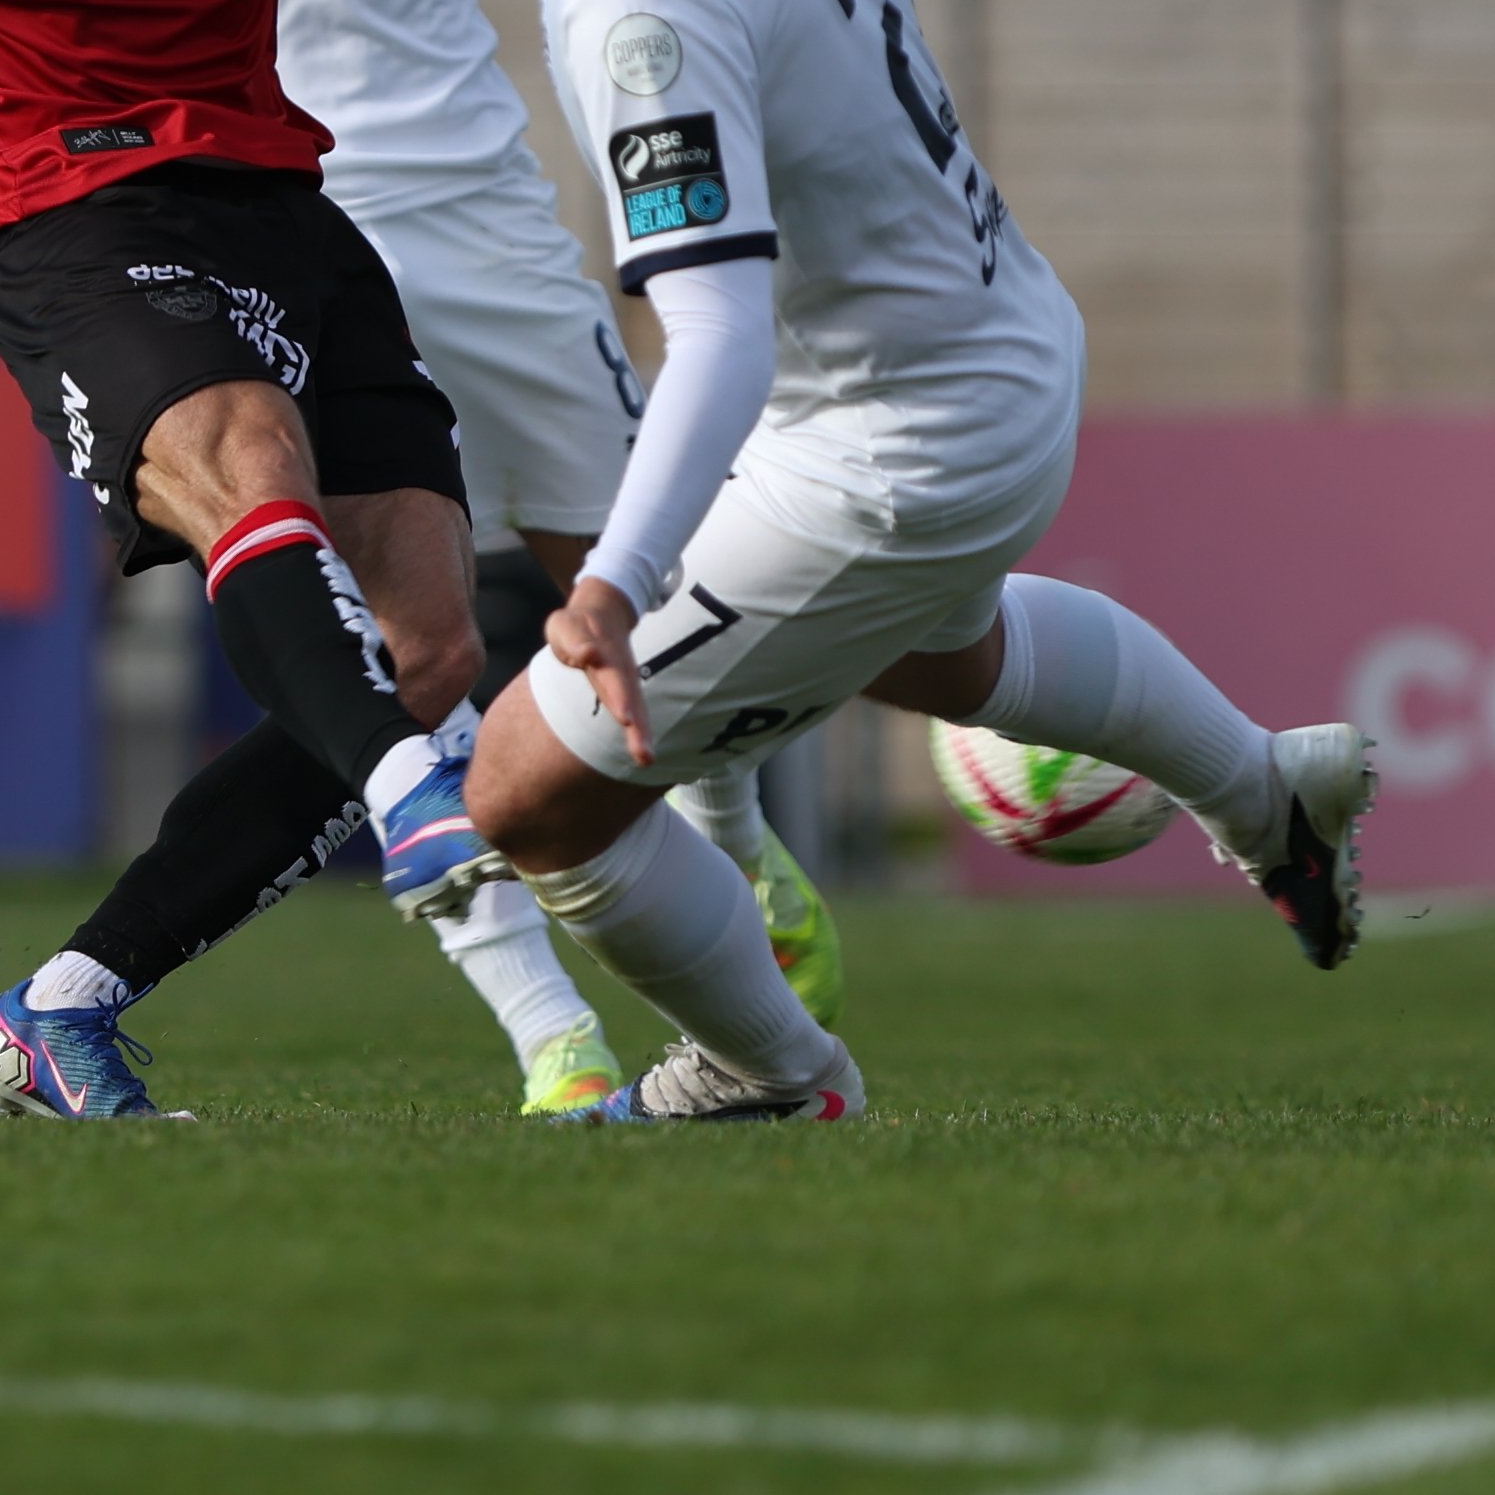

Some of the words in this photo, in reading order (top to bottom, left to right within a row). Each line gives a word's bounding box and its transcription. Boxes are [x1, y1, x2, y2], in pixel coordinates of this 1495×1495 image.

[611, 32, 673, 65] COPPERS
[648, 130, 683, 152] sse
[653, 145, 712, 169] Airtricity
[625, 188, 665, 214] LEAGUE
[666, 183, 683, 205] OF
[628, 203, 687, 238] IRELAND
